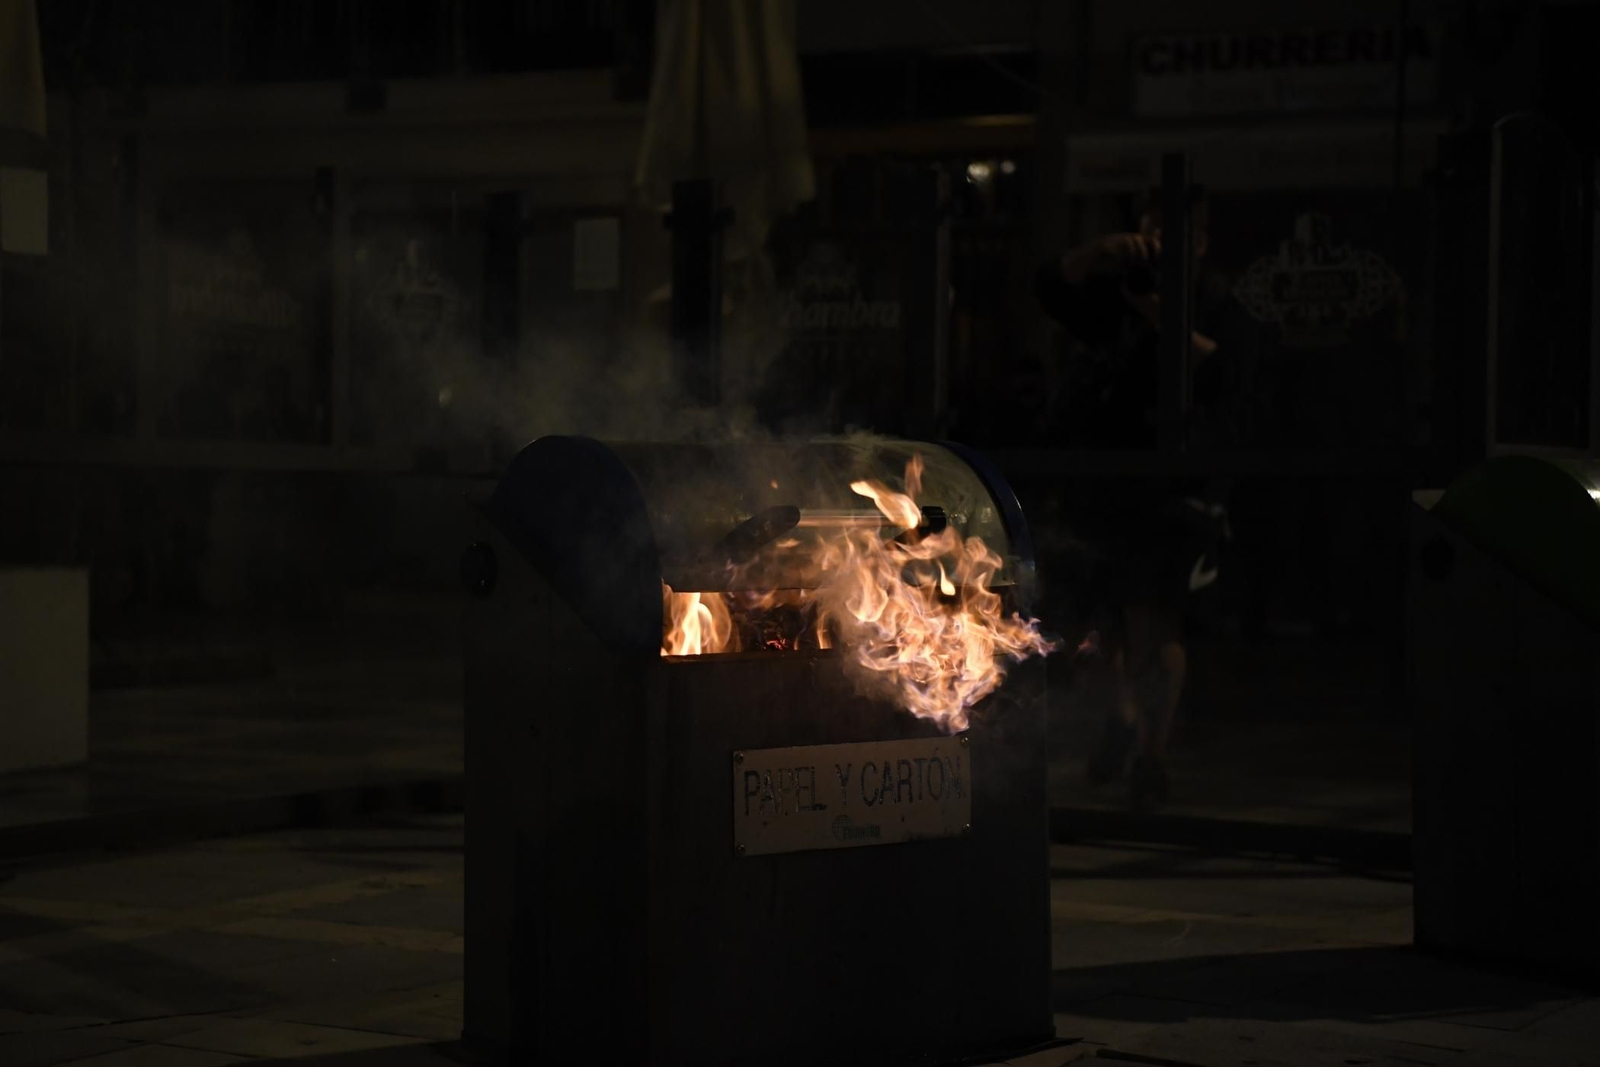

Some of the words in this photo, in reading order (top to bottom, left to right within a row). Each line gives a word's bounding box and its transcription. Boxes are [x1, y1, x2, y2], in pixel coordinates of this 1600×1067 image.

[1140, 25, 1432, 74] CHURRERIA
[743, 764, 828, 816] PAPEL
[834, 763, 852, 811] Y
[860, 746, 961, 807] CARTÓN
